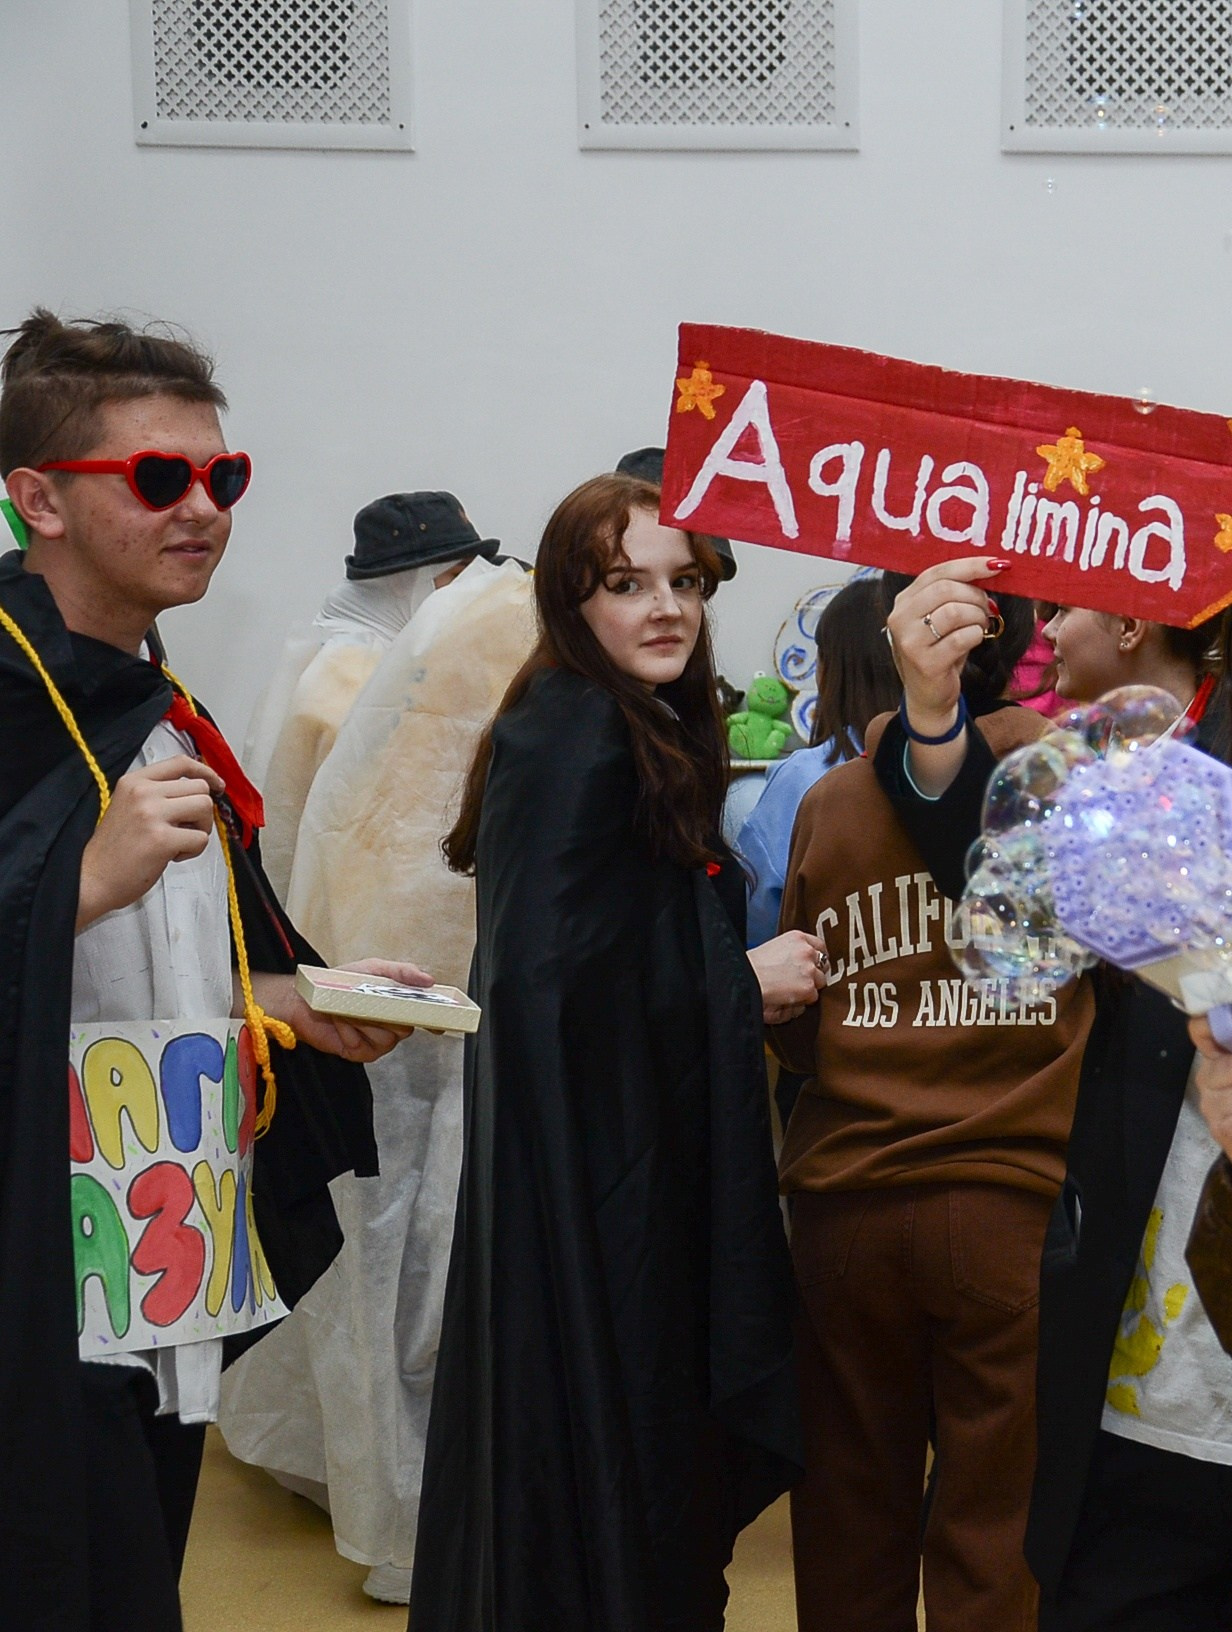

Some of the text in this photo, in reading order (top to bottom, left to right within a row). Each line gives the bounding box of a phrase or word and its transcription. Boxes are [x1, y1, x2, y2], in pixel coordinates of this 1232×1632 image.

[673, 379, 1187, 592] Aqua limina
[842, 977, 1058, 1028] LOS ANGELES
